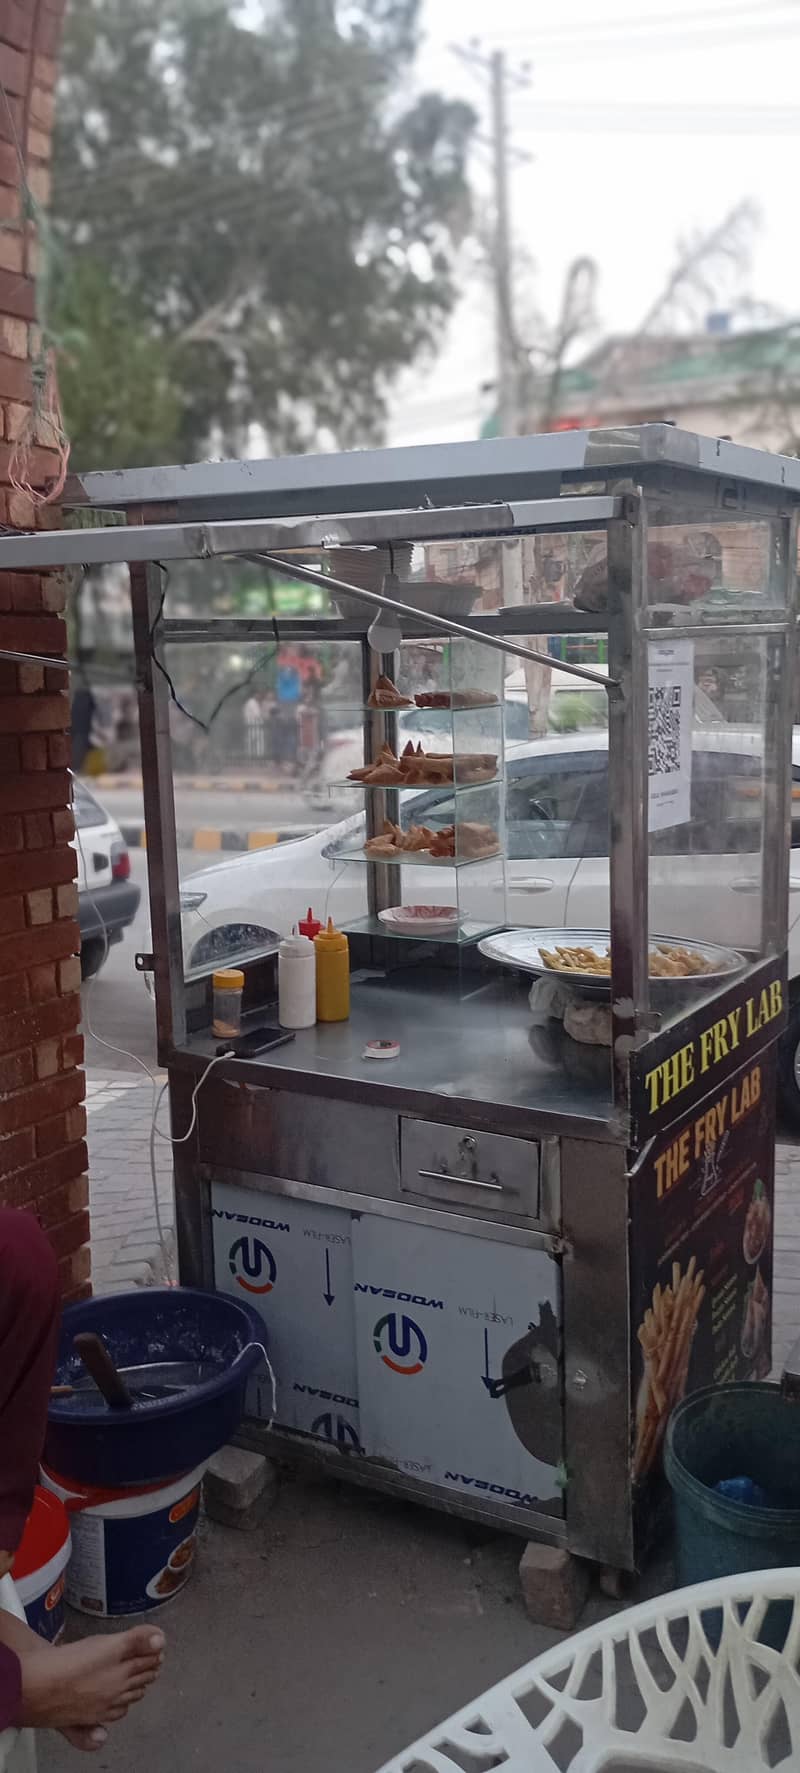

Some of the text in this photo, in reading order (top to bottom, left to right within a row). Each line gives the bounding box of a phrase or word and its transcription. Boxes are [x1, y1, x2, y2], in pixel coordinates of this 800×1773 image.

[645, 979, 782, 1114] THE FRY LAB
[654, 1067, 761, 1198] THE FRY LAB
[211, 1209, 290, 1233] WOOSAN
[354, 1283, 444, 1310] WOOSAN
[293, 1383, 360, 1408] OOSAN
[444, 1471, 539, 1504] WOOSAN
